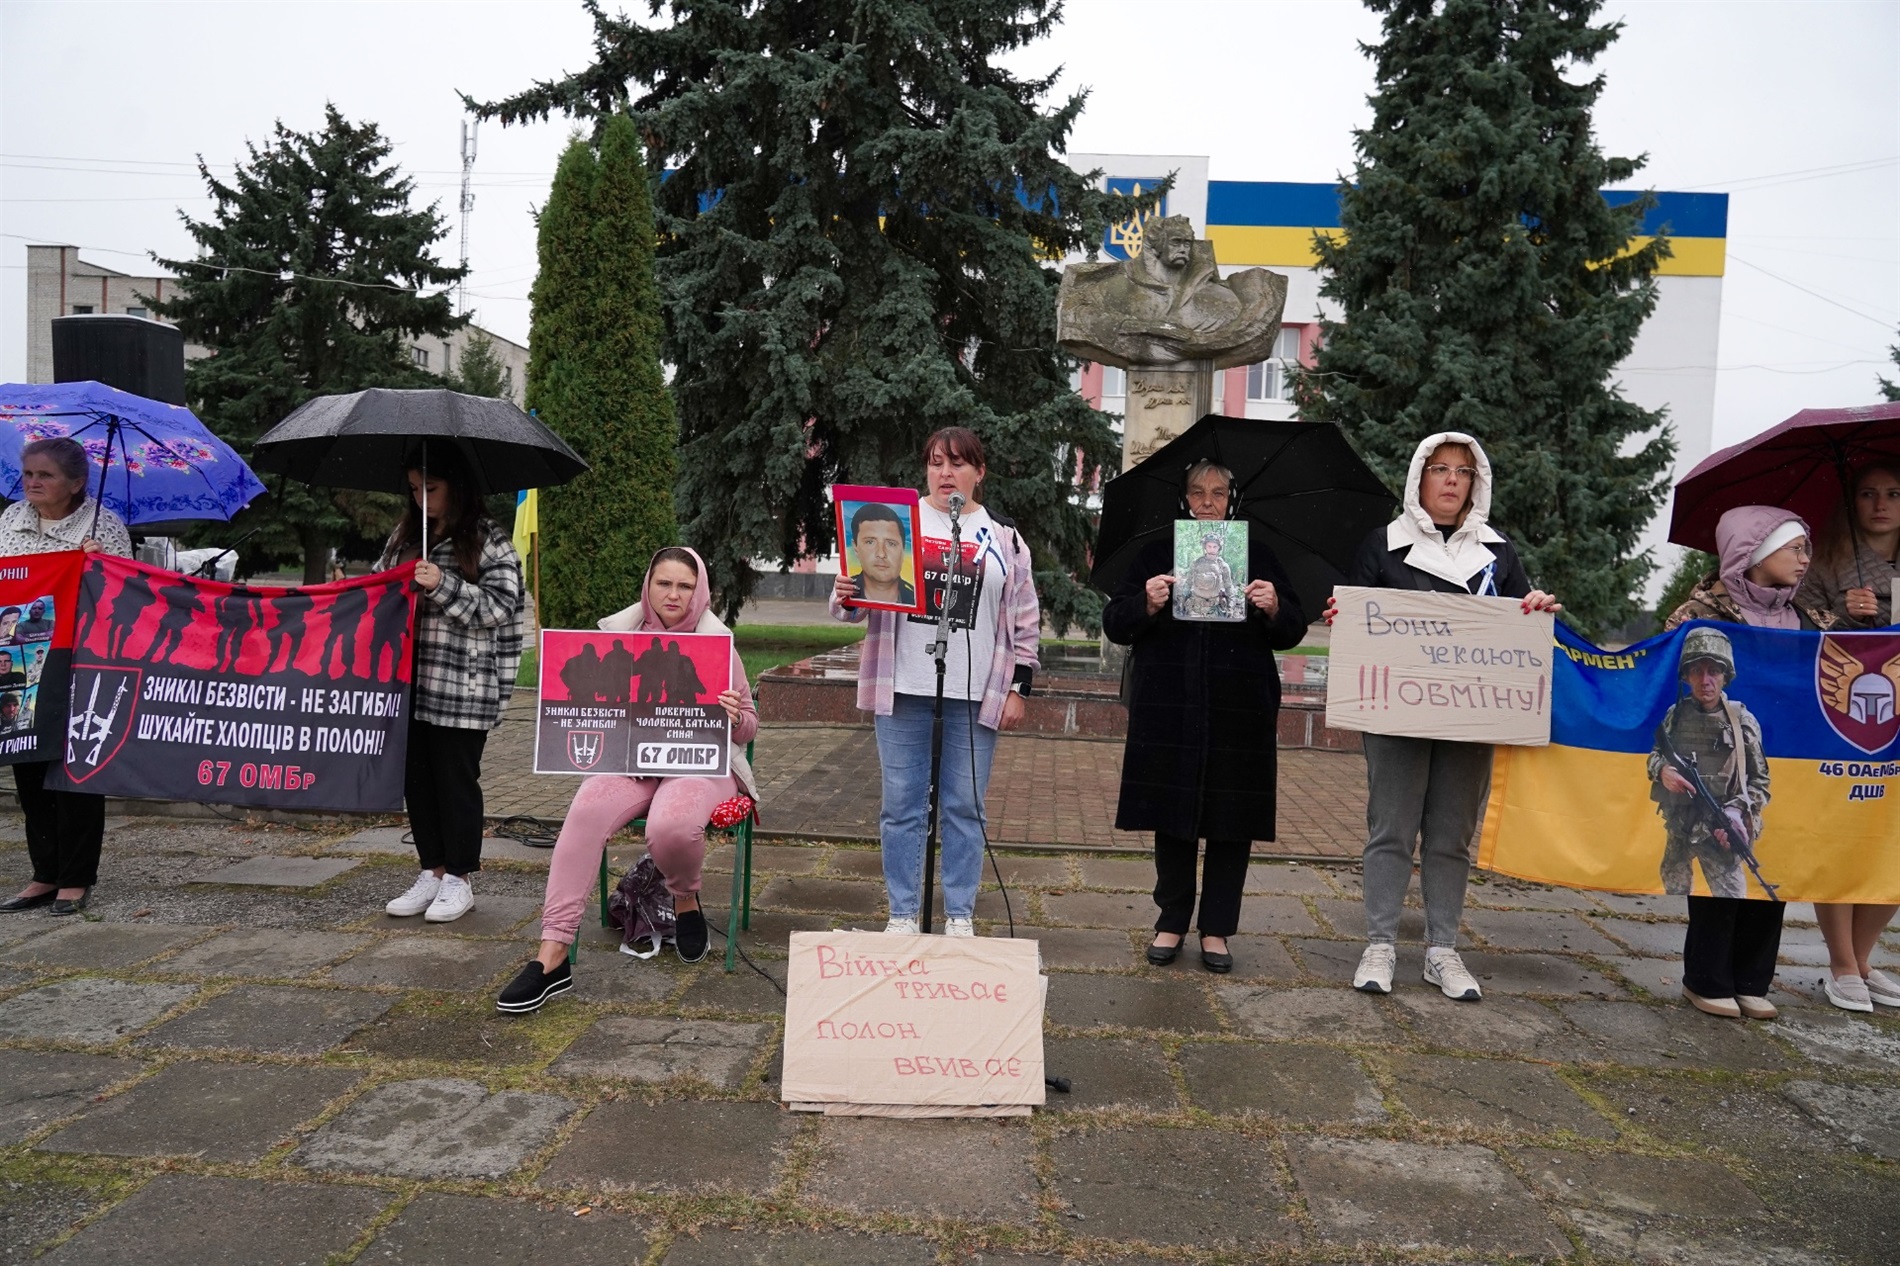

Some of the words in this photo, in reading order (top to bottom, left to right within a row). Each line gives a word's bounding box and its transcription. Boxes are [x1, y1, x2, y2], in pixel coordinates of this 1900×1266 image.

[924, 571, 938, 580] 67
[1366, 601, 1453, 636] Вони
[1420, 644, 1543, 668] чекають
[143, 675, 202, 704] ЗНИКЛІ
[204, 680, 285, 711] БЕЗВІСТИ
[301, 688, 325, 713] НЕ
[328, 688, 402, 718] ЗАГИБЛІ!
[544, 706, 579, 716] ЗНИКЛІ
[580, 707, 626, 718] БЕЗВІСТИ
[655, 706, 706, 717] ПОВЕРНІТЬ
[560, 719, 576, 728] НЕ
[577, 719, 618, 729] ЗАГИБЛІ!
[636, 717, 683, 729] ЧОЛОВІКА,
[685, 719, 725, 730] БАТЬКА,
[137, 711, 214, 746] ШУКАЙТЕ
[215, 719, 293, 754] ХЛОПЦІВ
[298, 726, 311, 752] В
[316, 726, 386, 755] ПОЛОНІ!
[666, 729, 694, 739] СИНА!
[640, 747, 661, 764] 67
[197, 760, 232, 786] 67
[1818, 762, 1845, 777] 46
[1848, 784, 1886, 802] ДШВ
[816, 944, 930, 979] Війна
[894, 980, 1008, 1004] триває
